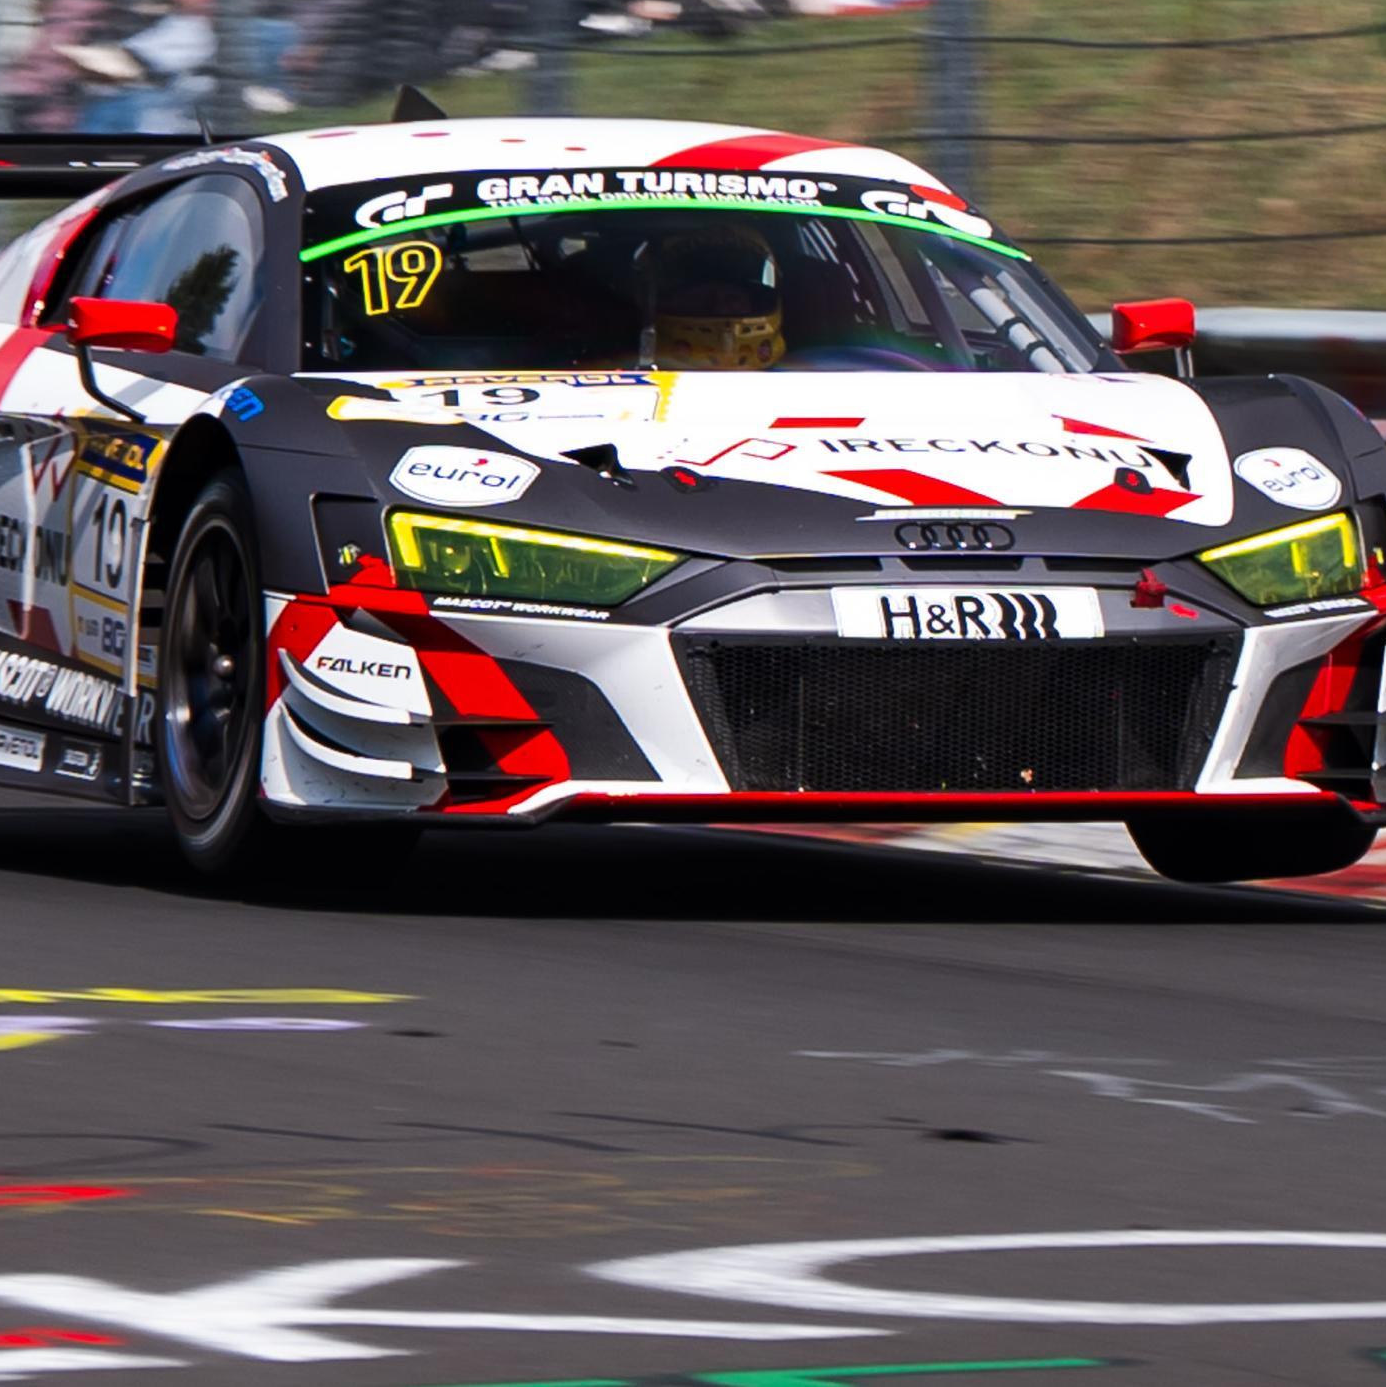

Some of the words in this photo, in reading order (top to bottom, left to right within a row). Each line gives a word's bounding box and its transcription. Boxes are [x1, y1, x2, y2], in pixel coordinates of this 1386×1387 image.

[477, 172, 605, 202] GRAN
[343, 240, 443, 316] 19
[420, 386, 541, 408] 19
[818, 438, 1154, 469] IRECKONU
[407, 462, 521, 490] eurol
[880, 594, 992, 639] H&R
[317, 656, 412, 680] FALKEN
[45, 666, 156, 745] WORKWER
